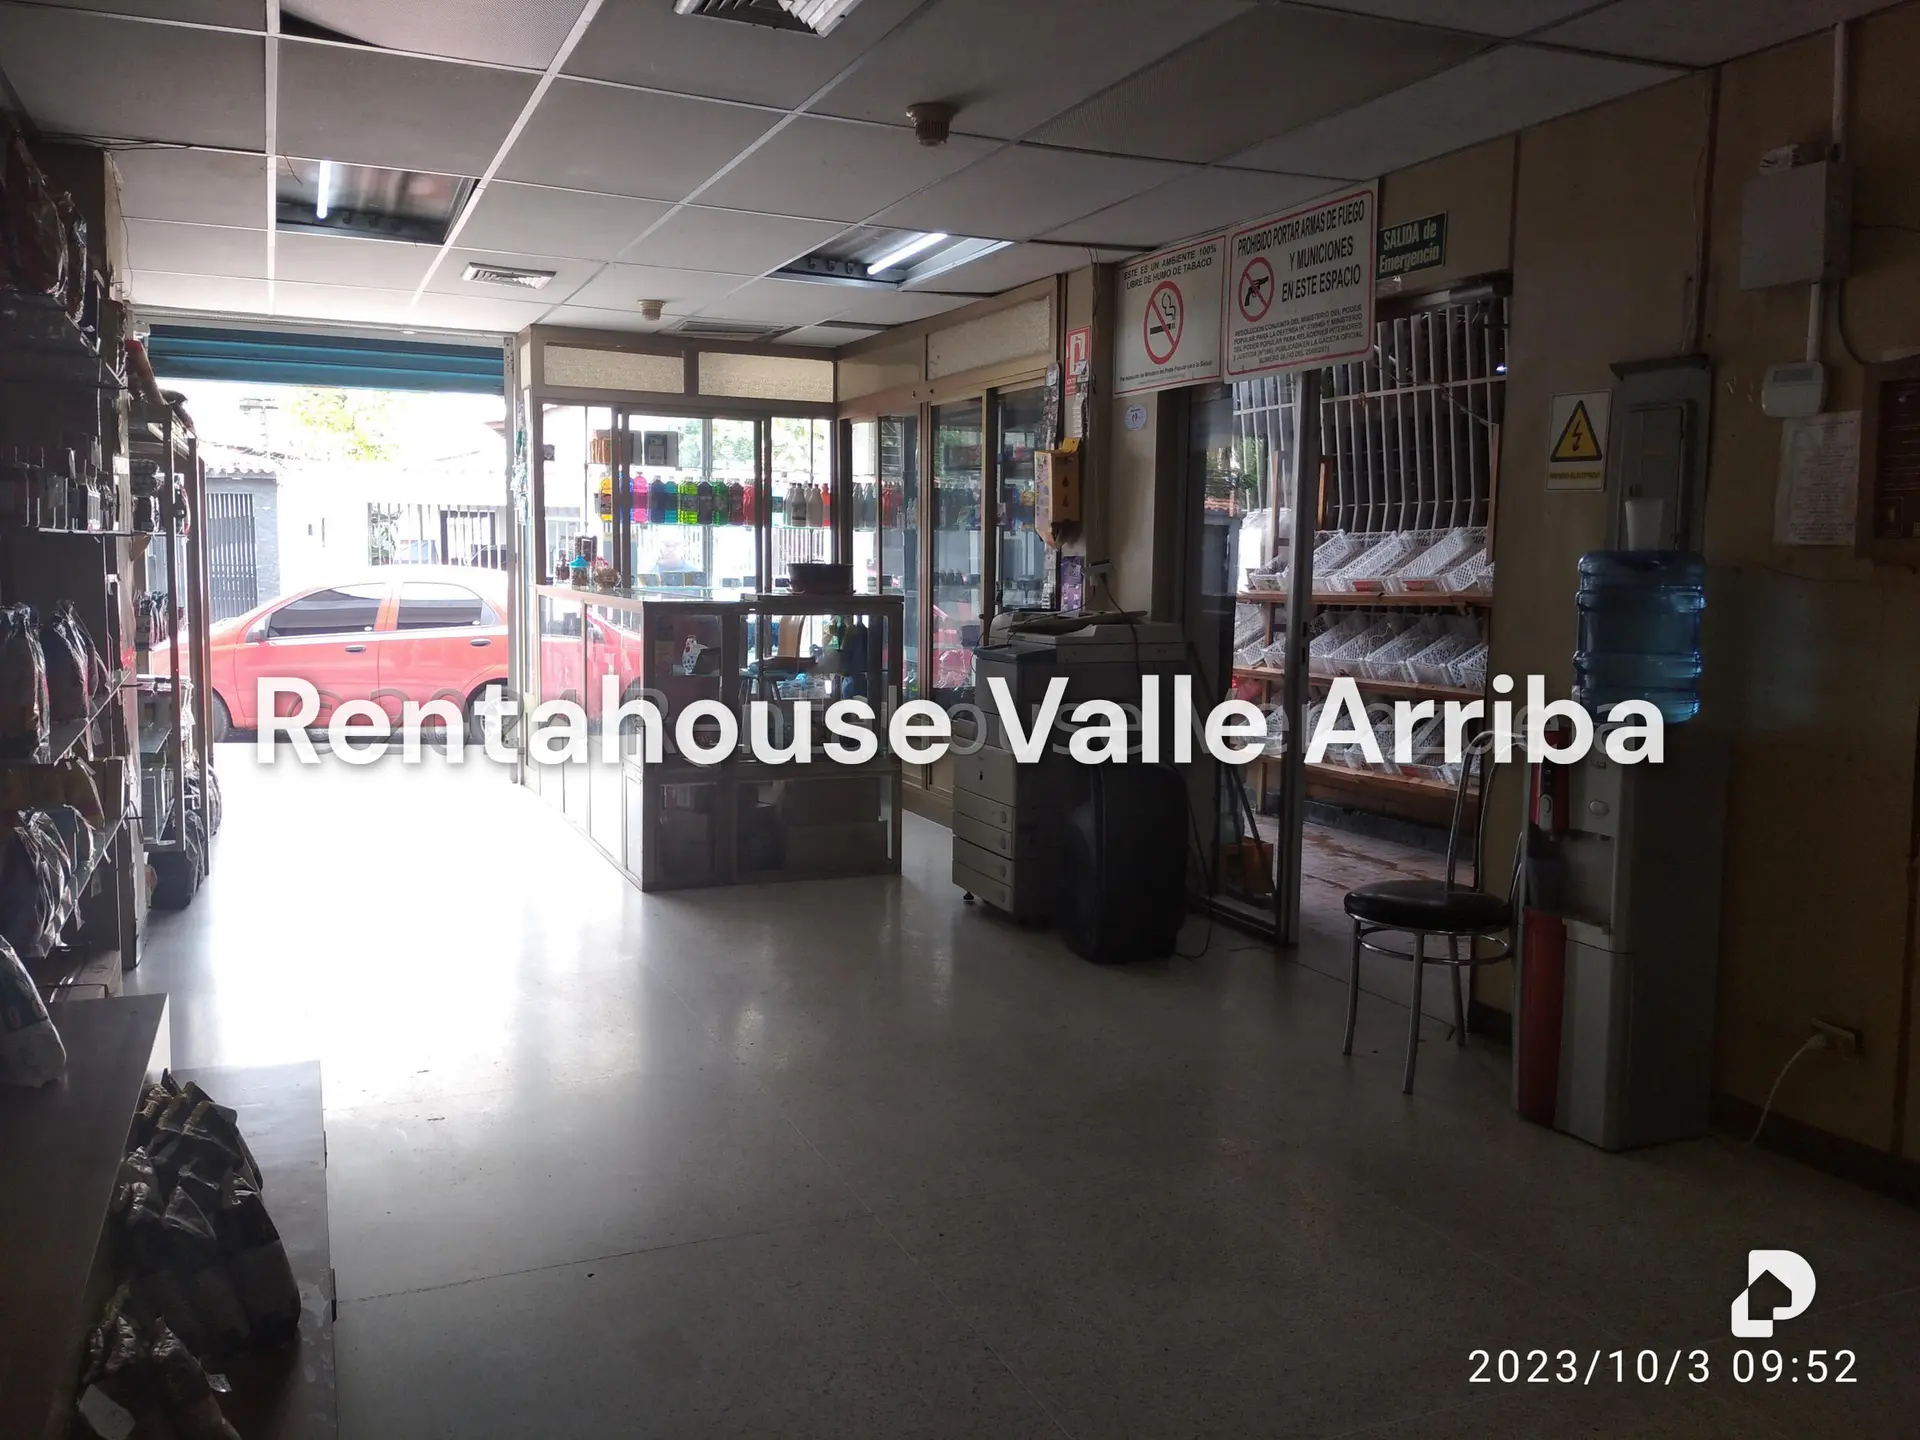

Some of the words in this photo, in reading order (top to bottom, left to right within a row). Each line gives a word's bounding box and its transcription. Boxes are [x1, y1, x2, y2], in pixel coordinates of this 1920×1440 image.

[1237, 230, 1272, 258] PROHIBIDO
[1273, 220, 1300, 247] PORTAR
[1300, 211, 1325, 238] ARMAS
[1326, 207, 1336, 230] DE
[1337, 199, 1364, 227] FUEGO
[1383, 222, 1419, 251] SALIDA
[1423, 219, 1437, 240] de
[1123, 268, 1138, 281] ESTE
[1140, 265, 1148, 275] ES
[1150, 262, 1159, 271] UN
[1161, 250, 1196, 267] AMBIENTE
[1199, 243, 1217, 257] 100%
[1289, 251, 1295, 272] Y
[1296, 235, 1354, 270] MUNICIONES
[1378, 243, 1440, 274] Emergencia
[1126, 278, 1143, 290] LIBRE
[1143, 275, 1152, 284] DE
[1152, 269, 1172, 281] HUMO
[1172, 267, 1182, 277] DE
[1183, 257, 1212, 273] TABACO
[1281, 282, 1293, 302] EN
[1295, 276, 1317, 299] ESTE
[1319, 263, 1361, 293] ESPACIO
